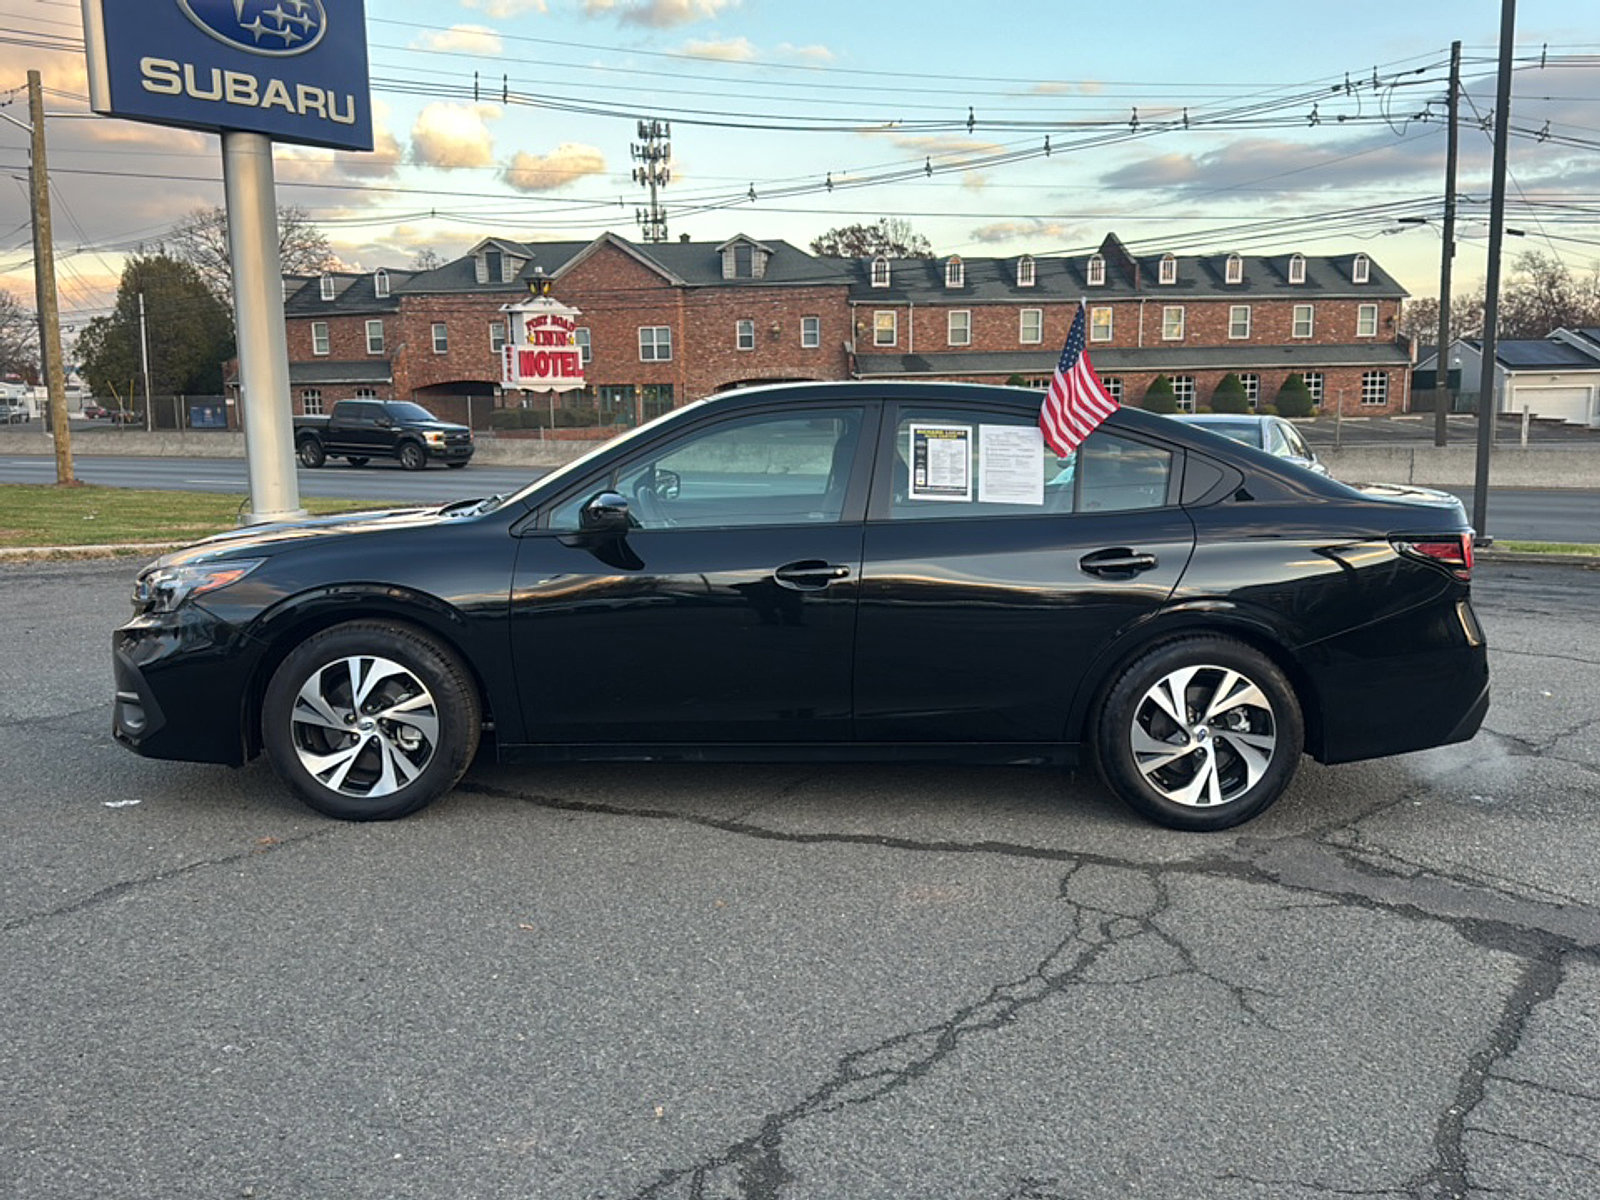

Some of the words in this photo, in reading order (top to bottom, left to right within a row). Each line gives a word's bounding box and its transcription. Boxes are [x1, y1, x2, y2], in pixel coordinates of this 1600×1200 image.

[140, 56, 356, 125] SUBARU
[534, 330, 567, 346] INN
[518, 350, 585, 377] MOTEL
